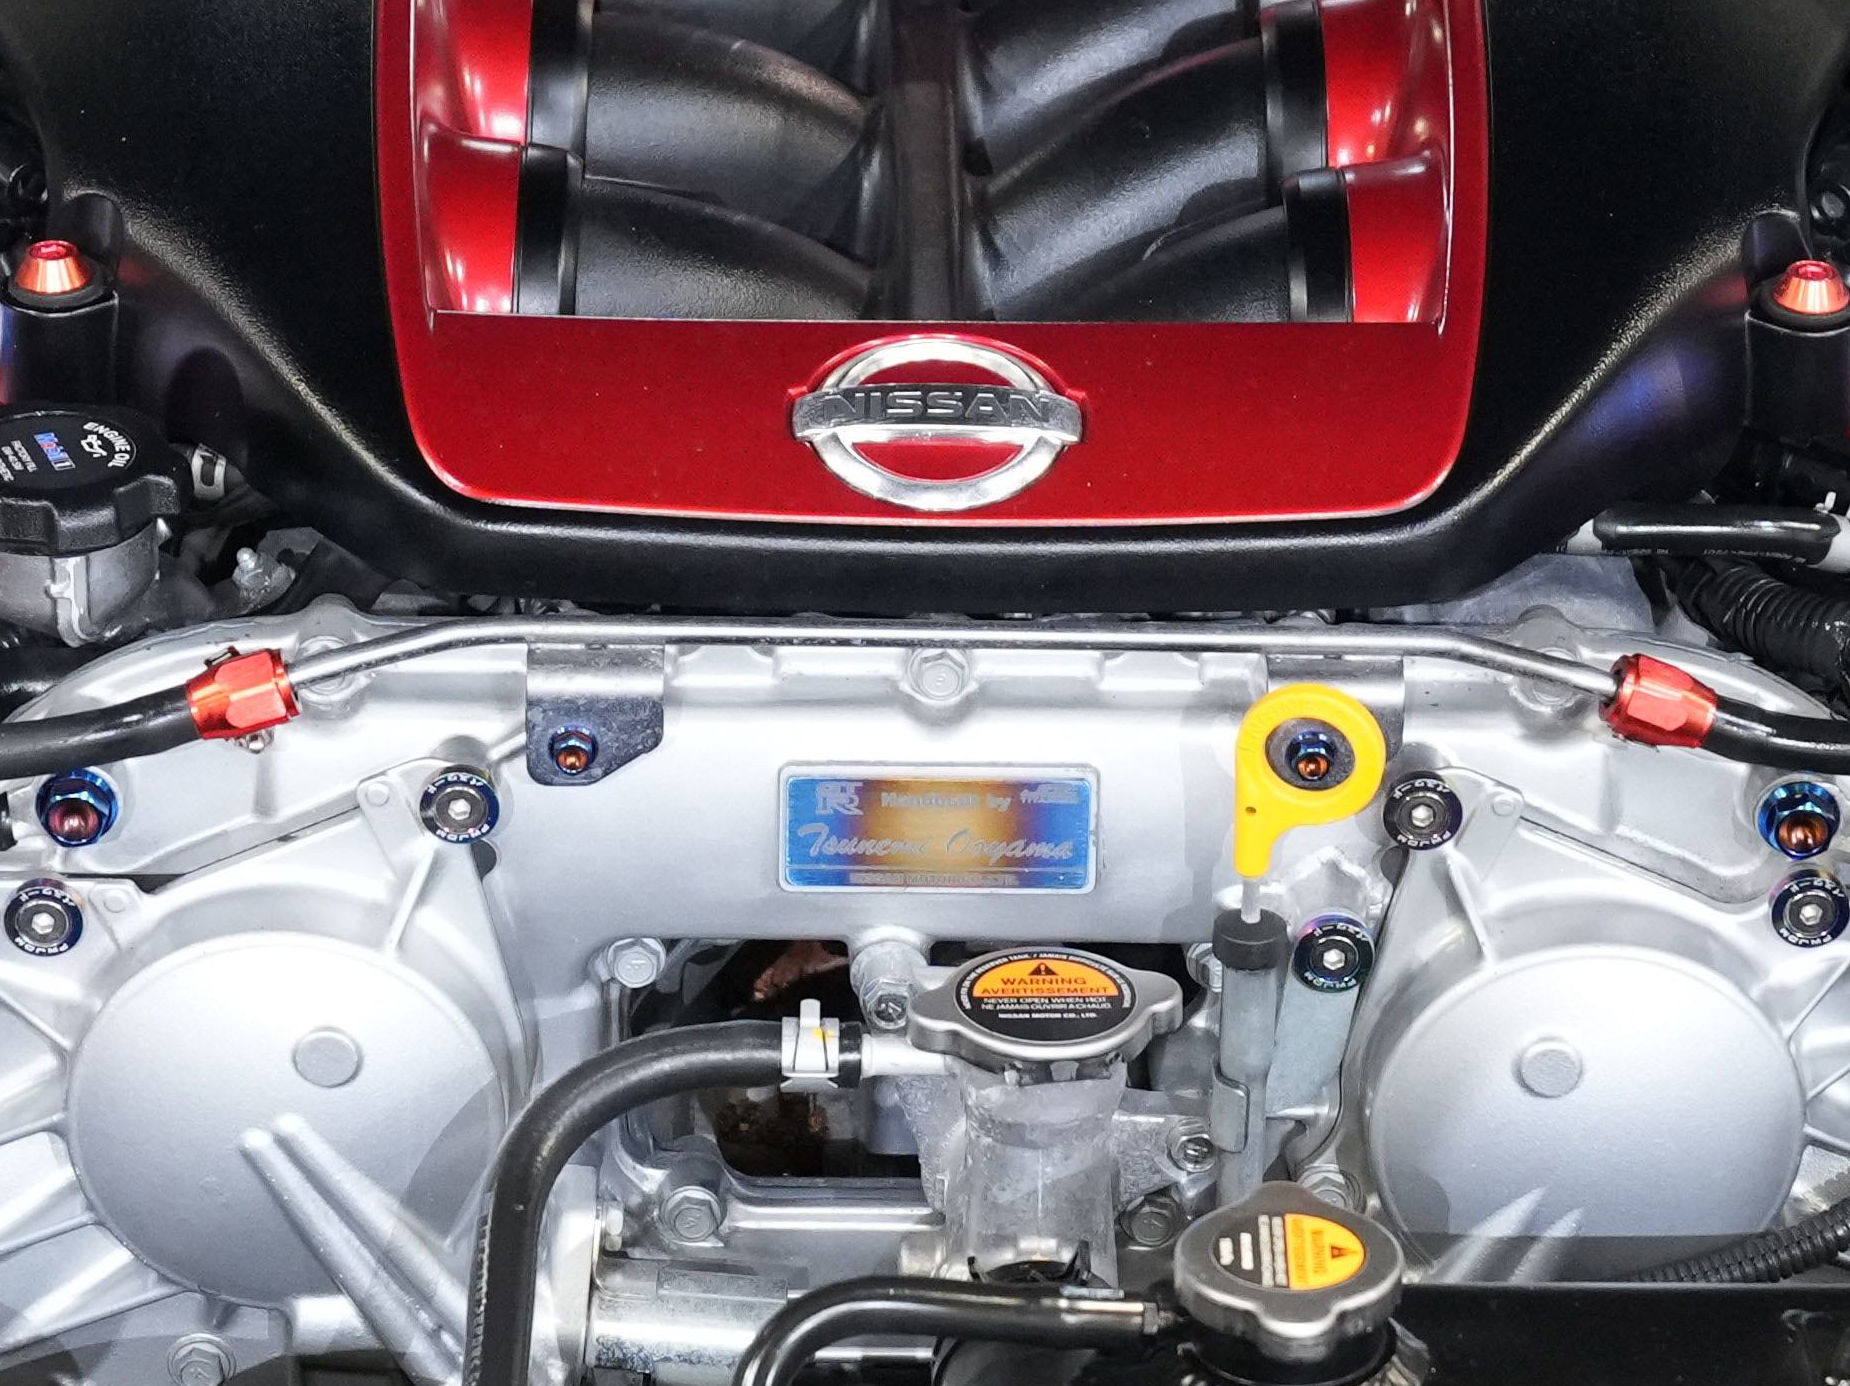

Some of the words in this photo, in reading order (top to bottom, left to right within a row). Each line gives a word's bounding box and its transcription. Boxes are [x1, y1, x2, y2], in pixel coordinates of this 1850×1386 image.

[821, 390, 1051, 424] NISSAN
[82, 421, 132, 452] ENGINE
[106, 451, 132, 469] OIL
[437, 823, 490, 844] PWJDM
[1397, 830, 1451, 849] PWJDM
[1778, 926, 1832, 946] PWJDM
[15, 936, 68, 956] PWJDM
[1000, 977, 1087, 986] WARNING
[1303, 971, 1357, 990] PWJDM
[981, 986, 1109, 995] AVERTISSEMENT
